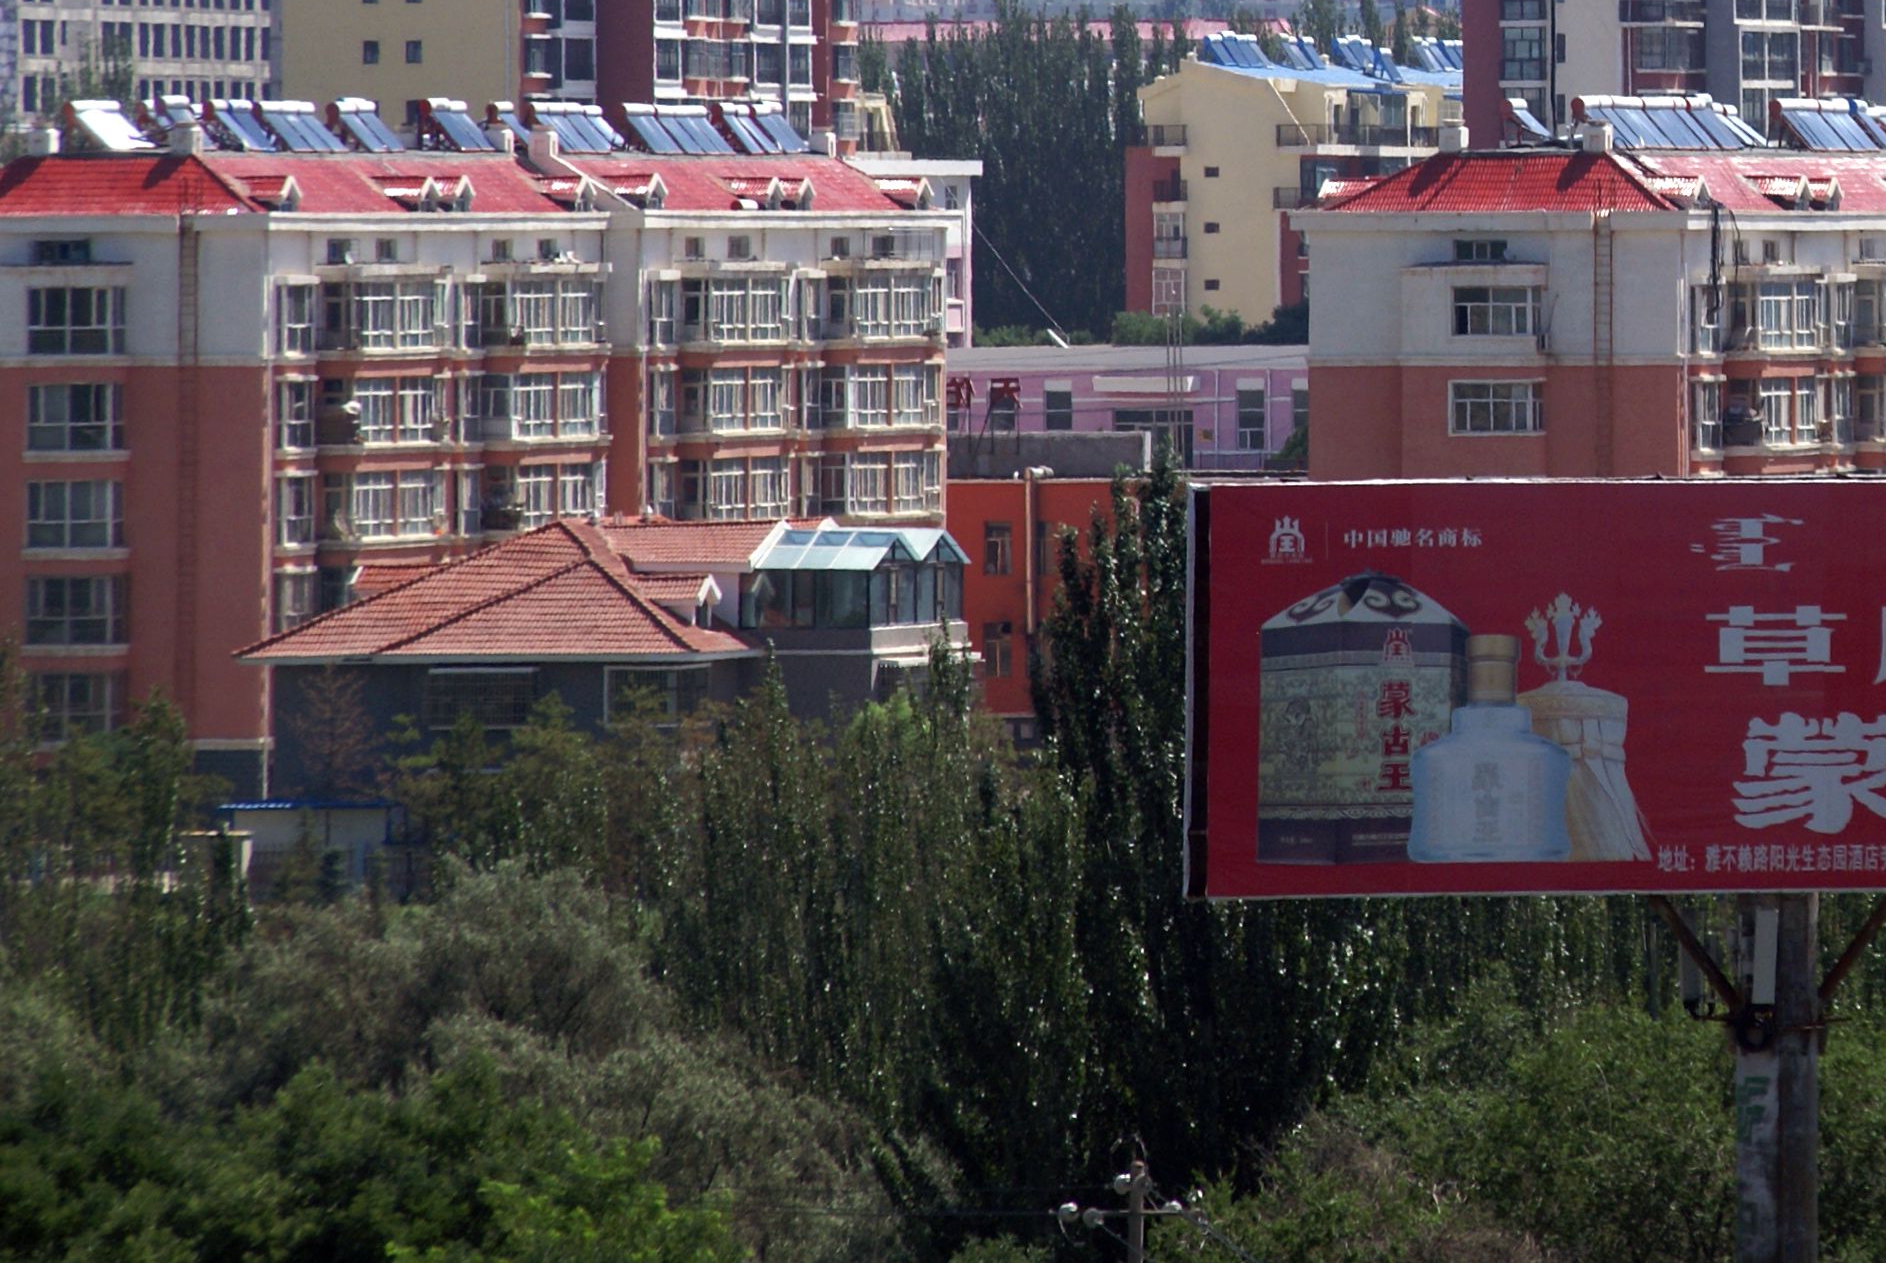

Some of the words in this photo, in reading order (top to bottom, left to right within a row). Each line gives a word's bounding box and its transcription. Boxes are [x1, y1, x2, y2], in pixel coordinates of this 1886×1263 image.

[1343, 528, 1482, 549] 中国驰名商标
[1376, 681, 1417, 791] 蒙古王
